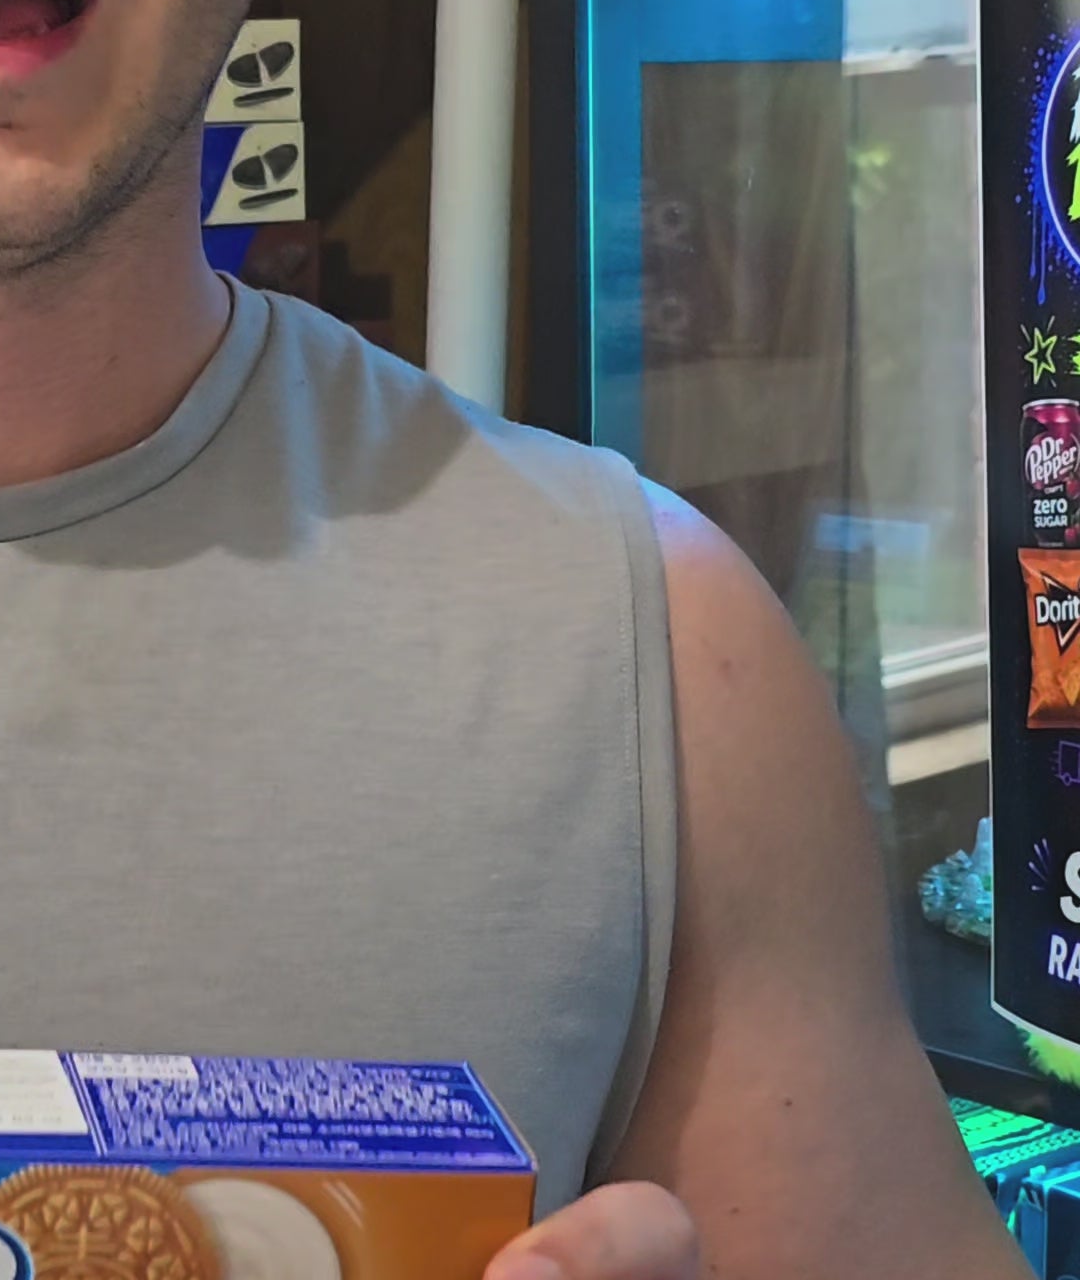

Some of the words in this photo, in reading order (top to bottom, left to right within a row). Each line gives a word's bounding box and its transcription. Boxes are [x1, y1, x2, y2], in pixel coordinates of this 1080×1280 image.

[1024, 444, 1078, 485] Pepper
[1033, 497, 1069, 515] zero
[1034, 515, 1069, 529] SUGAR
